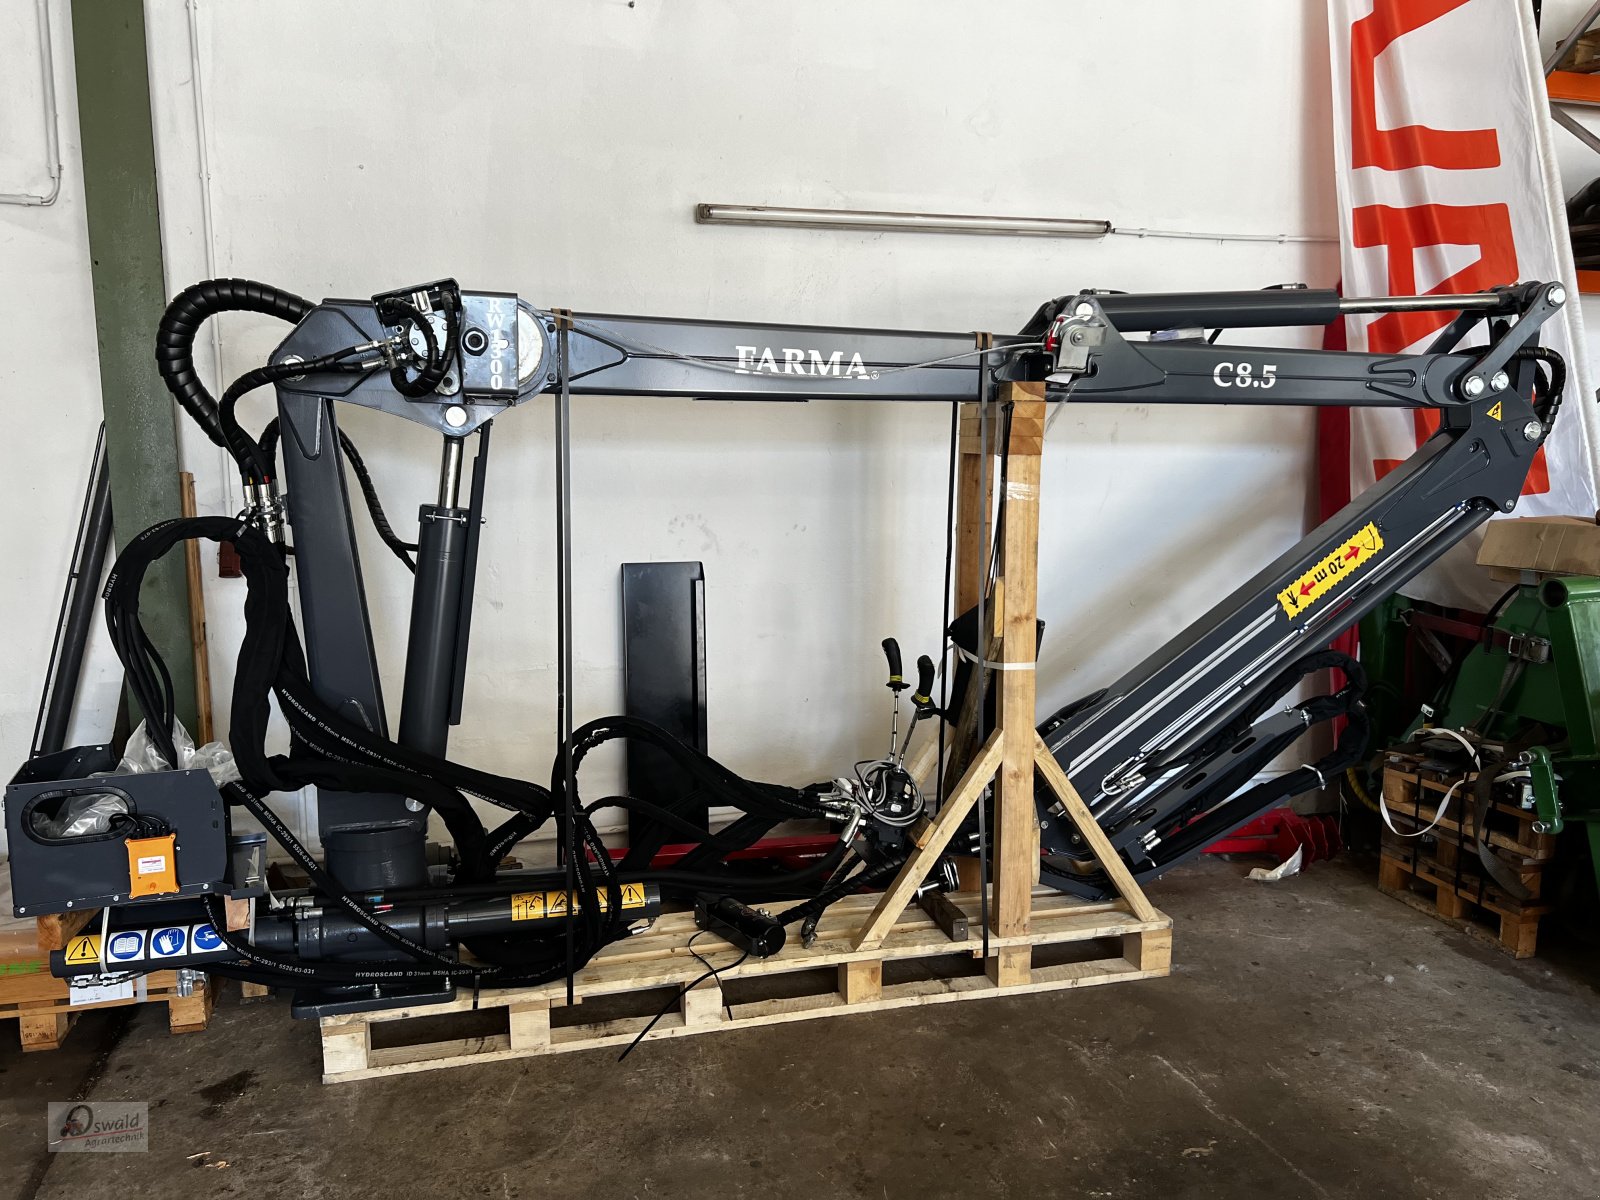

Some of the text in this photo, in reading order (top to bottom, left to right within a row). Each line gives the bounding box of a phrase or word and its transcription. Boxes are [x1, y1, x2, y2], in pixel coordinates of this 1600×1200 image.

[735, 346, 870, 380] FARMA
[1213, 362, 1277, 389] C8.5
[1313, 555, 1346, 583] 20 m
[281, 688, 317, 722] HYDROSCAND
[341, 736, 357, 749] MSHA
[263, 810, 277, 826] MSHA
[276, 824, 294, 844] IC-293/1
[292, 843, 318, 871] 5526-63-031
[341, 895, 379, 926] HYDROSCAND
[278, 964, 315, 975] 5526-63-031
